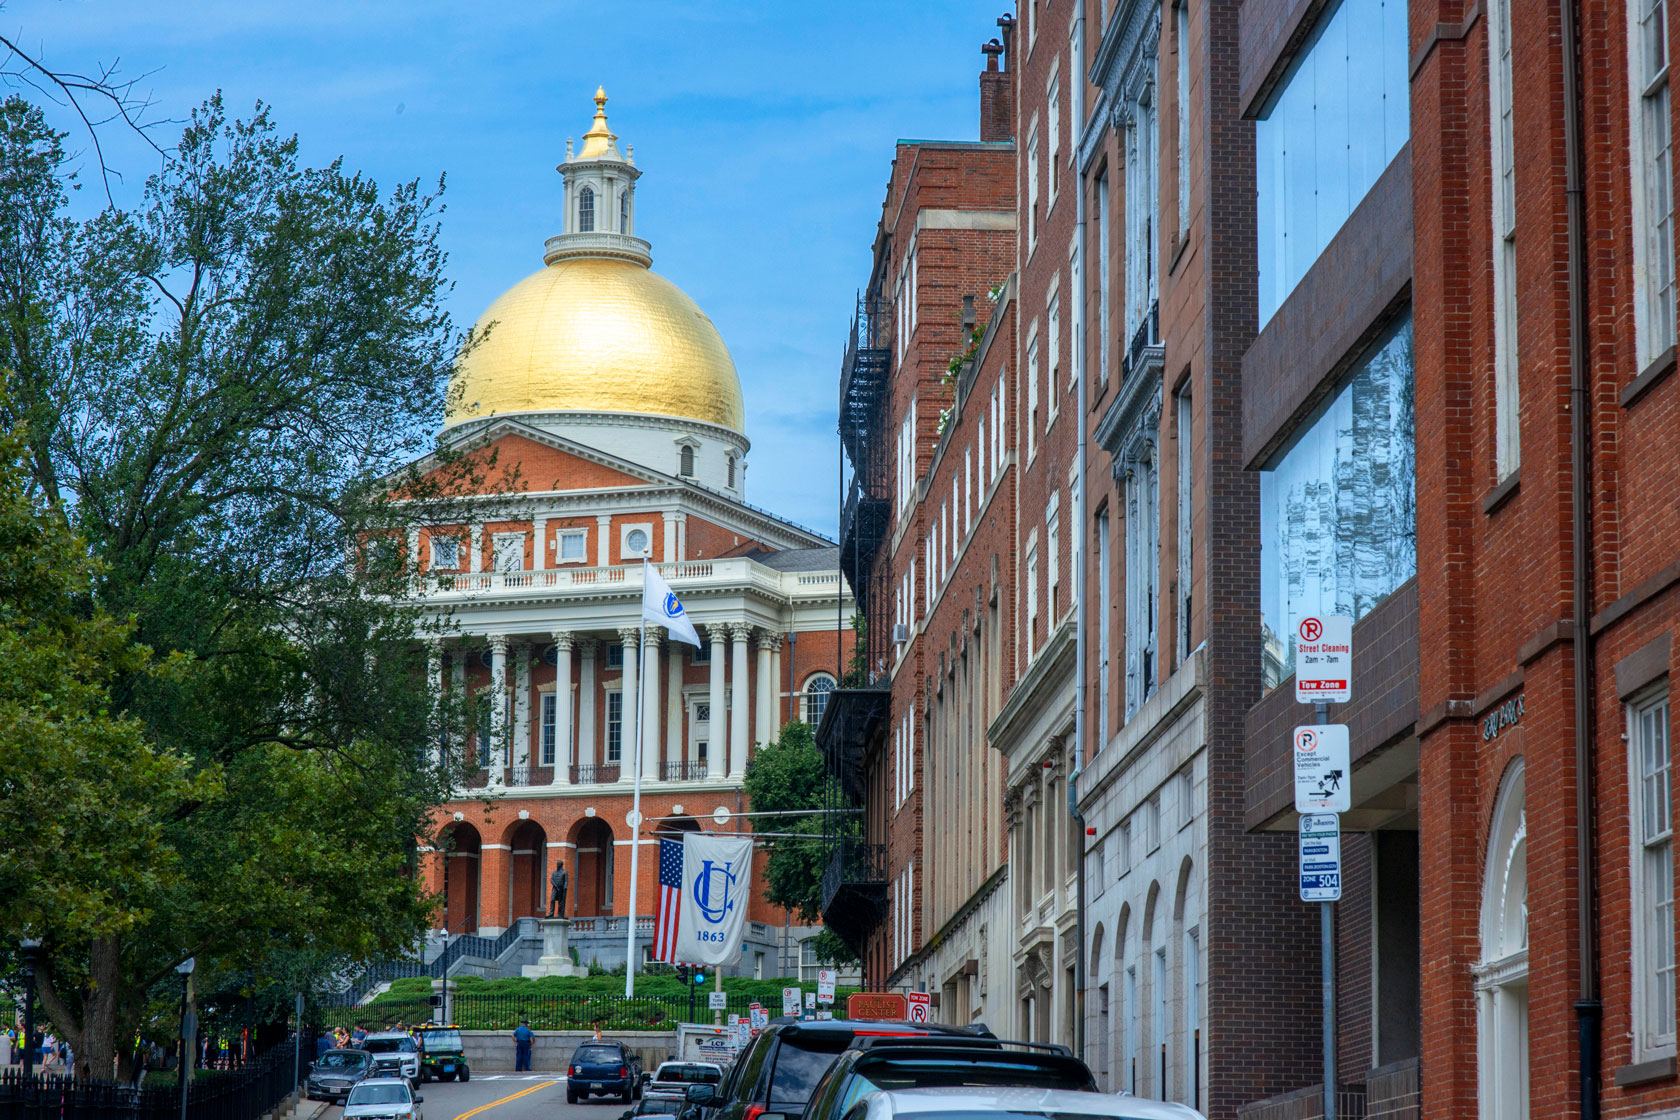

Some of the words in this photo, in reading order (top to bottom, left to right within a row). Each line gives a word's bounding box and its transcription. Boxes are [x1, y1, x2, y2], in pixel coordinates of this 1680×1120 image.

[1299, 643, 1319, 653] Street
[1322, 643, 1349, 654] Cleaning
[1305, 655, 1318, 664] 2am
[1326, 655, 1338, 663] 7am
[1320, 680, 1340, 688] Zone
[1319, 874, 1338, 887] 504
[697, 930, 724, 942] 1863
